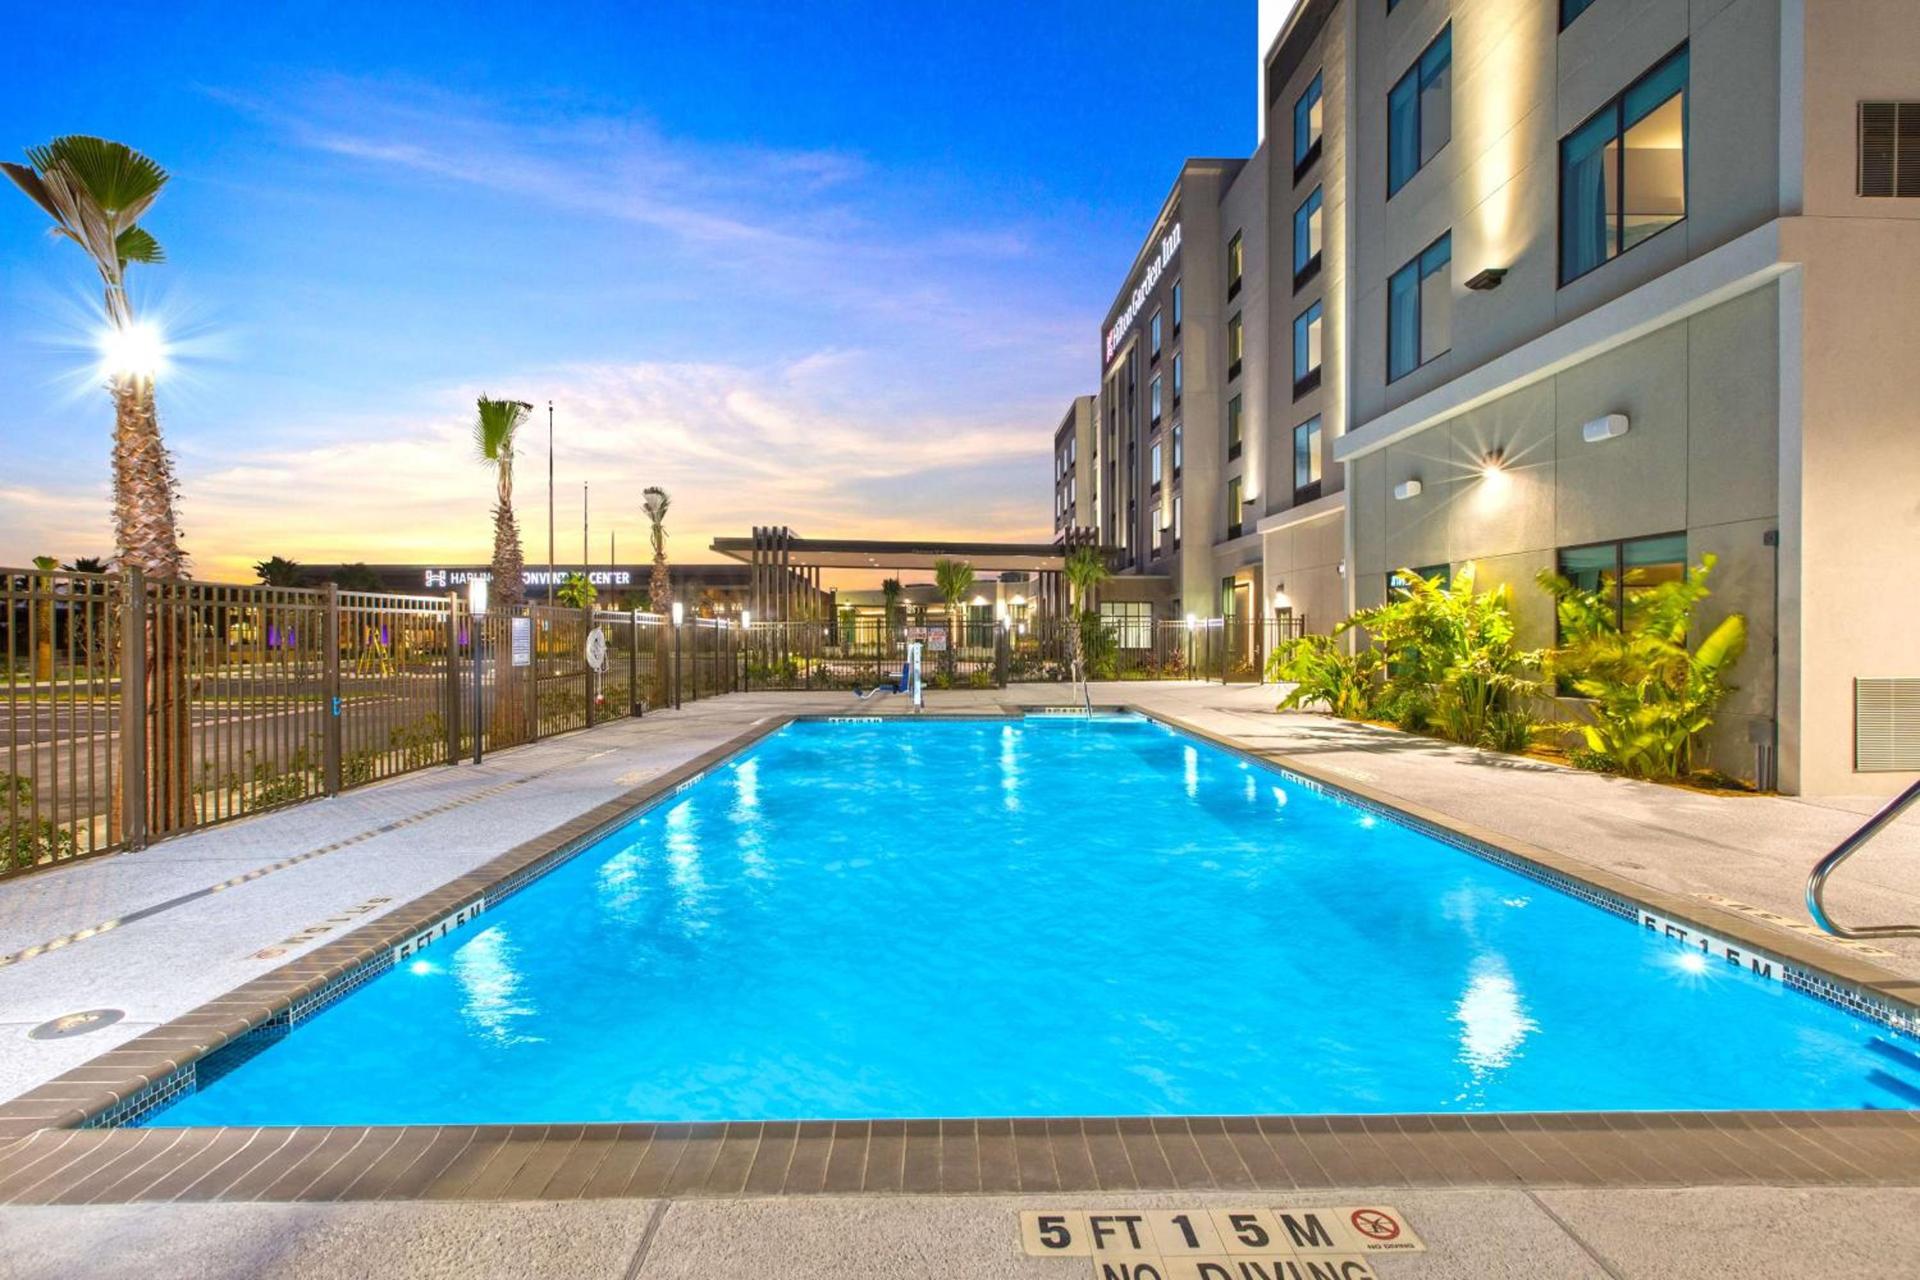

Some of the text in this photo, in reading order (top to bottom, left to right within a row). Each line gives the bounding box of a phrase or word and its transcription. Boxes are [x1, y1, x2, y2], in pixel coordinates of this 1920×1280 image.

[1133, 256, 1162, 316] Garden
[1162, 223, 1181, 268] Inn
[1699, 938, 1709, 954] 1
[1752, 958, 1771, 979] M
[1038, 1213, 1335, 1249] 5 FT 1 5 M
